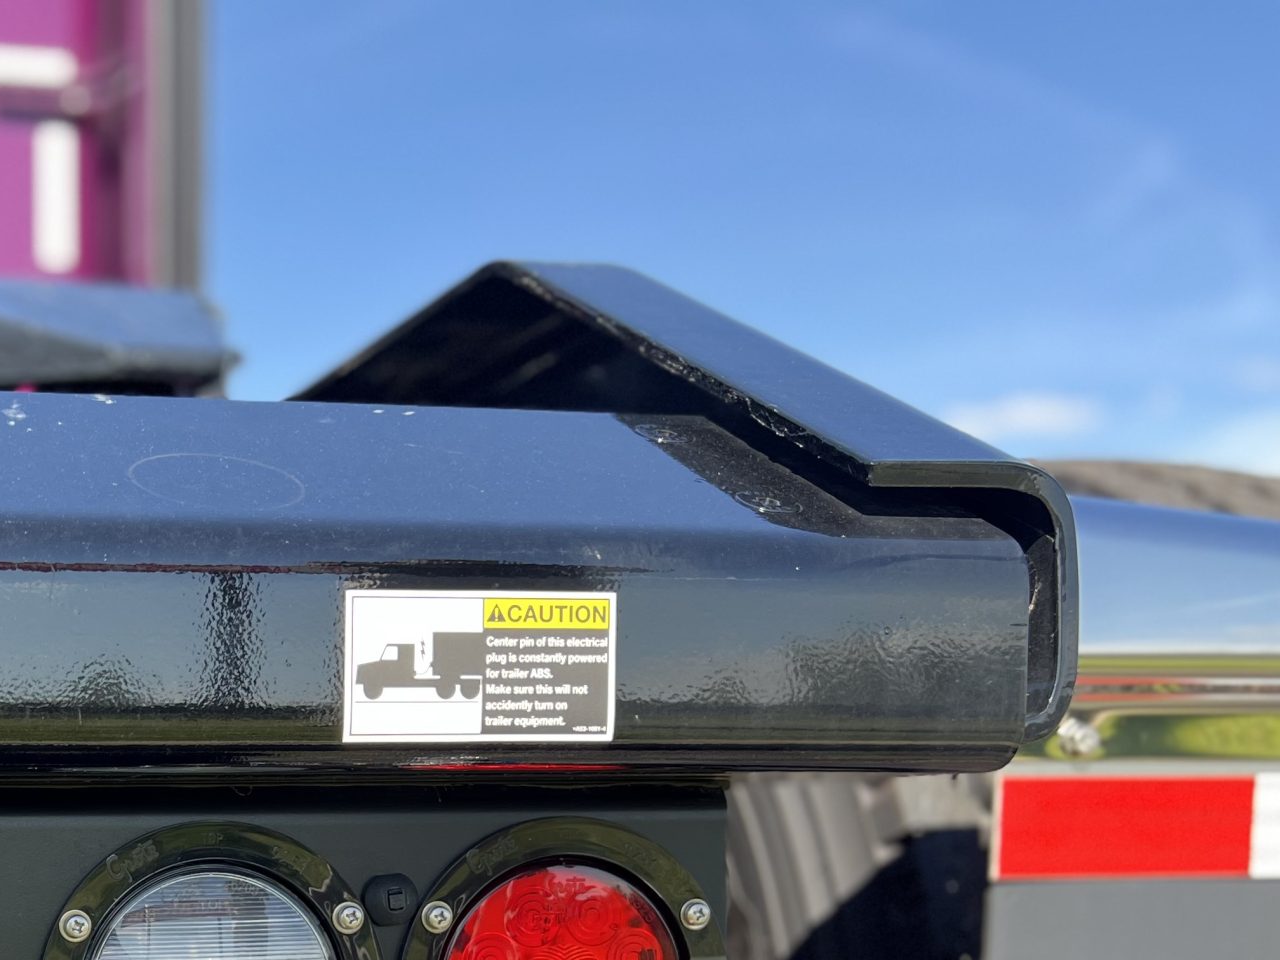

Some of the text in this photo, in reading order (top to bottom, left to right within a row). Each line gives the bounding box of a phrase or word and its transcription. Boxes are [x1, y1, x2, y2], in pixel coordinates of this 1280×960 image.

[507, 604, 607, 624] CAUTION
[486, 636, 608, 650] Center pin of this electrical
[485, 652, 608, 665] plug is constantly powered
[485, 668, 554, 679] for trailer ABS.
[485, 684, 588, 695] Make sure this will not
[485, 700, 568, 712] accidently turn on
[485, 716, 566, 728] trailer equipment.
